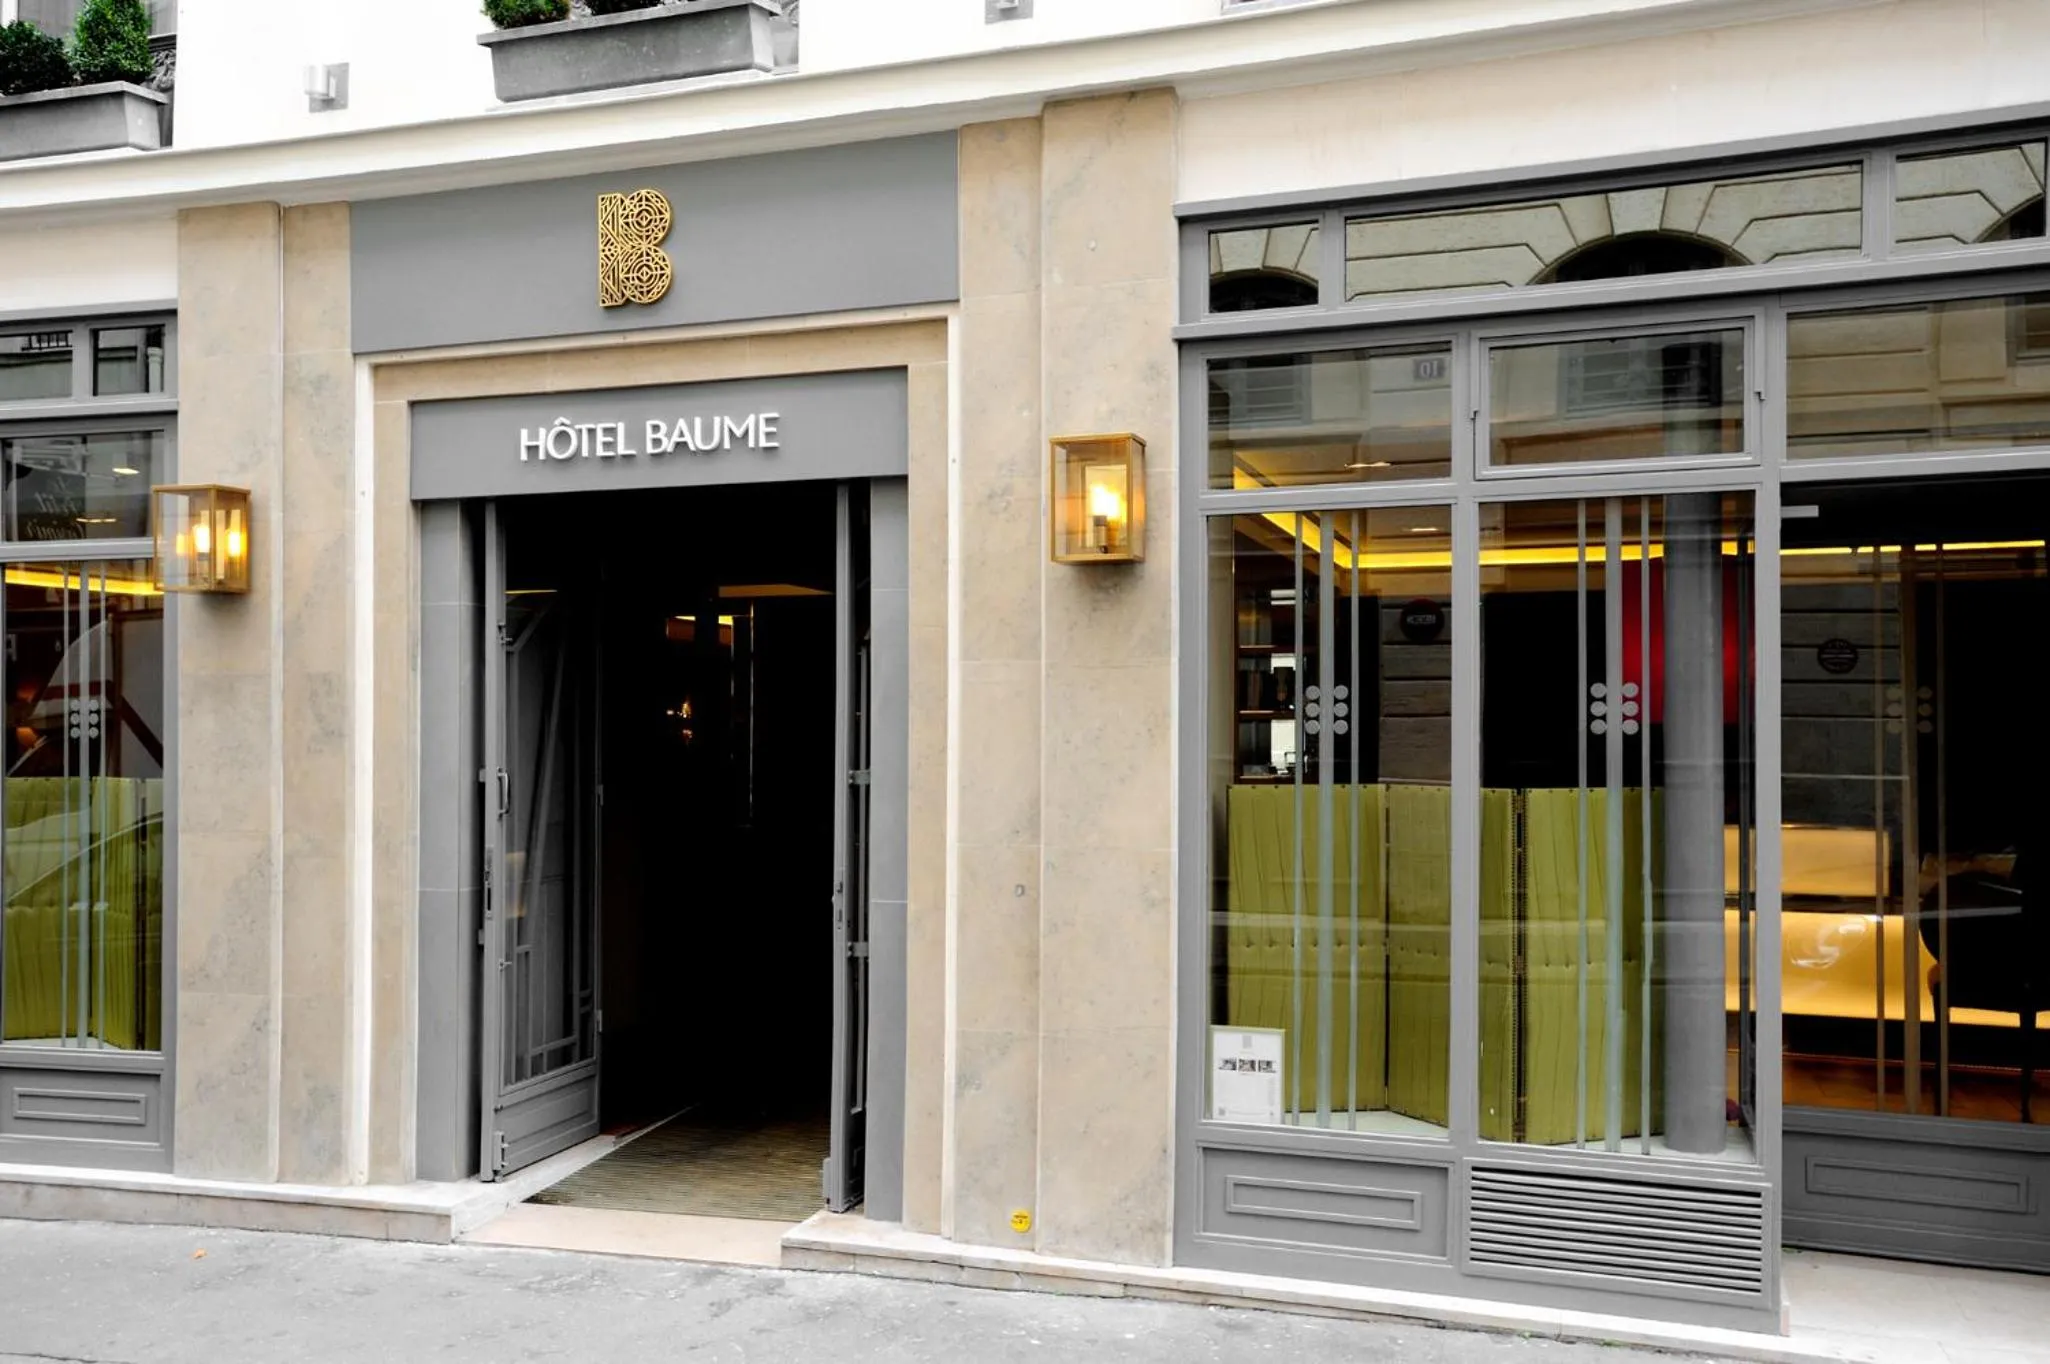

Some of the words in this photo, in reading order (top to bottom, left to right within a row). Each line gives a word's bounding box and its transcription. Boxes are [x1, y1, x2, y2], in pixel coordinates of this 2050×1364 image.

[598, 189, 672, 307] B
[519, 416, 638, 462] HÔTEL
[645, 412, 781, 456] BAUME
